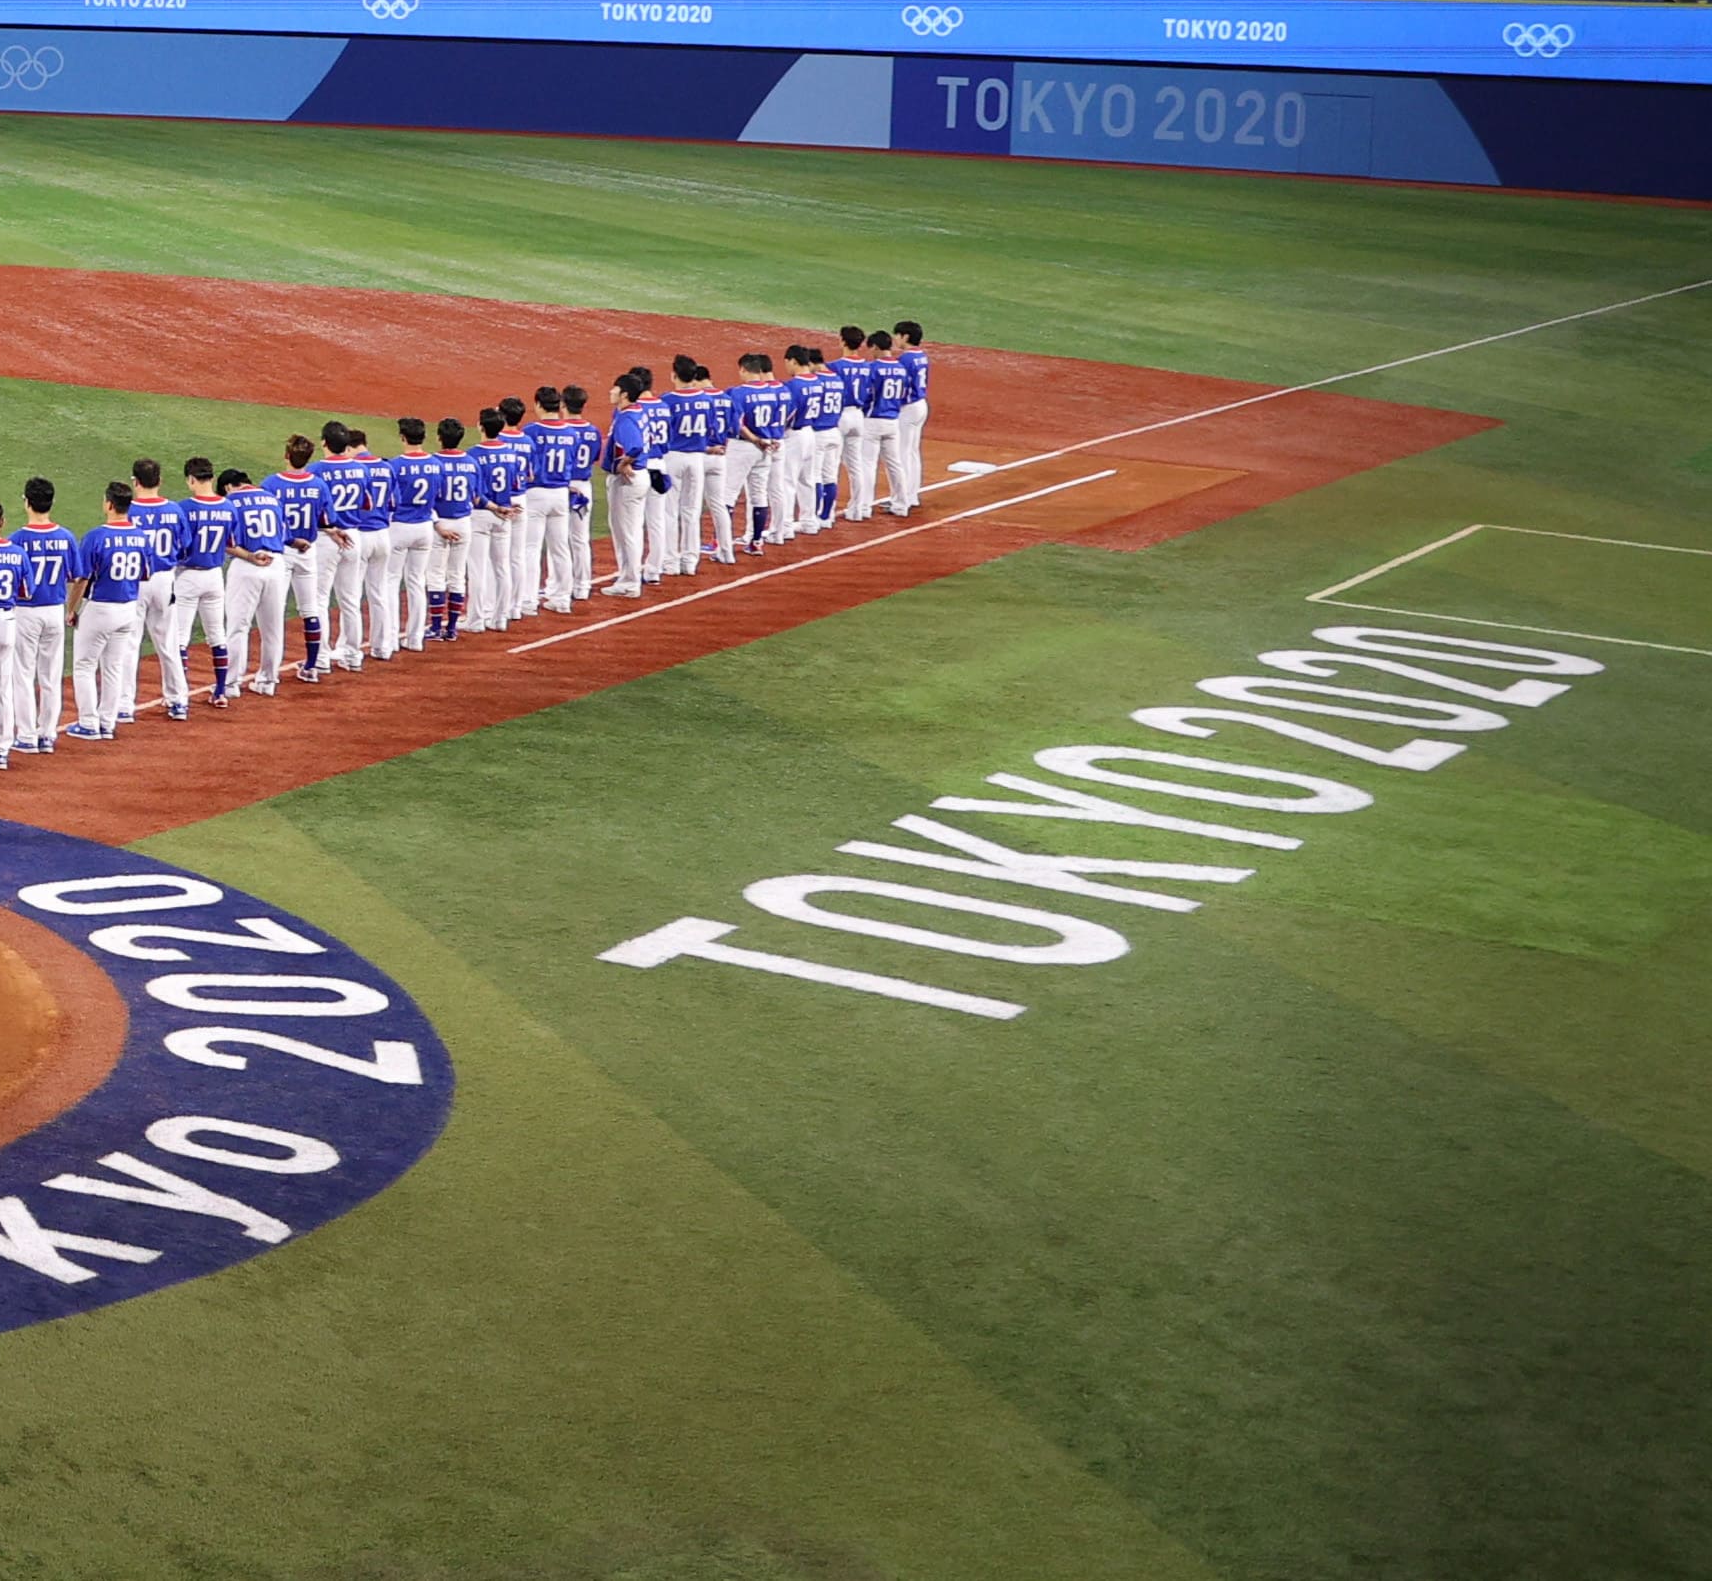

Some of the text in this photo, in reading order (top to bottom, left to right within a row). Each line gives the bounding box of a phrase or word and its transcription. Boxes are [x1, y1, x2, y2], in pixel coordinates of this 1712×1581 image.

[601, 3, 712, 23] TOKYO 2020
[1164, 19, 1287, 41] TOKYO 2020
[936, 76, 1305, 149] TOKYO 2020
[882, 379, 902, 399] 61
[805, 397, 820, 419] 25
[823, 391, 842, 413] 53
[678, 413, 707, 437] 44
[754, 405, 771, 427] 10
[400, 465, 440, 475] J H OH
[546, 449, 566, 473] 11
[334, 470, 342, 479] S
[344, 469, 364, 479] KIM
[492, 467, 506, 492] 3
[286, 488, 295, 499] H
[300, 488, 320, 499] LEE
[331, 483, 360, 511] 22
[412, 479, 428, 505] 2
[446, 475, 468, 501] 13
[131, 515, 143, 526] K
[146, 514, 155, 525] Y
[189, 511, 196, 521] H
[244, 509, 276, 539] 50
[284, 503, 312, 529] 51
[32, 540, 41, 551] K
[46, 539, 68, 551] KIM
[104, 536, 146, 548] J H KIM
[142, 527, 172, 557] 70
[198, 525, 224, 553] 17
[30, 555, 64, 585] 77
[110, 551, 142, 581] 88
[596, 626, 1607, 1020] TOKYO 2020
[17, 874, 424, 1085] 2020
